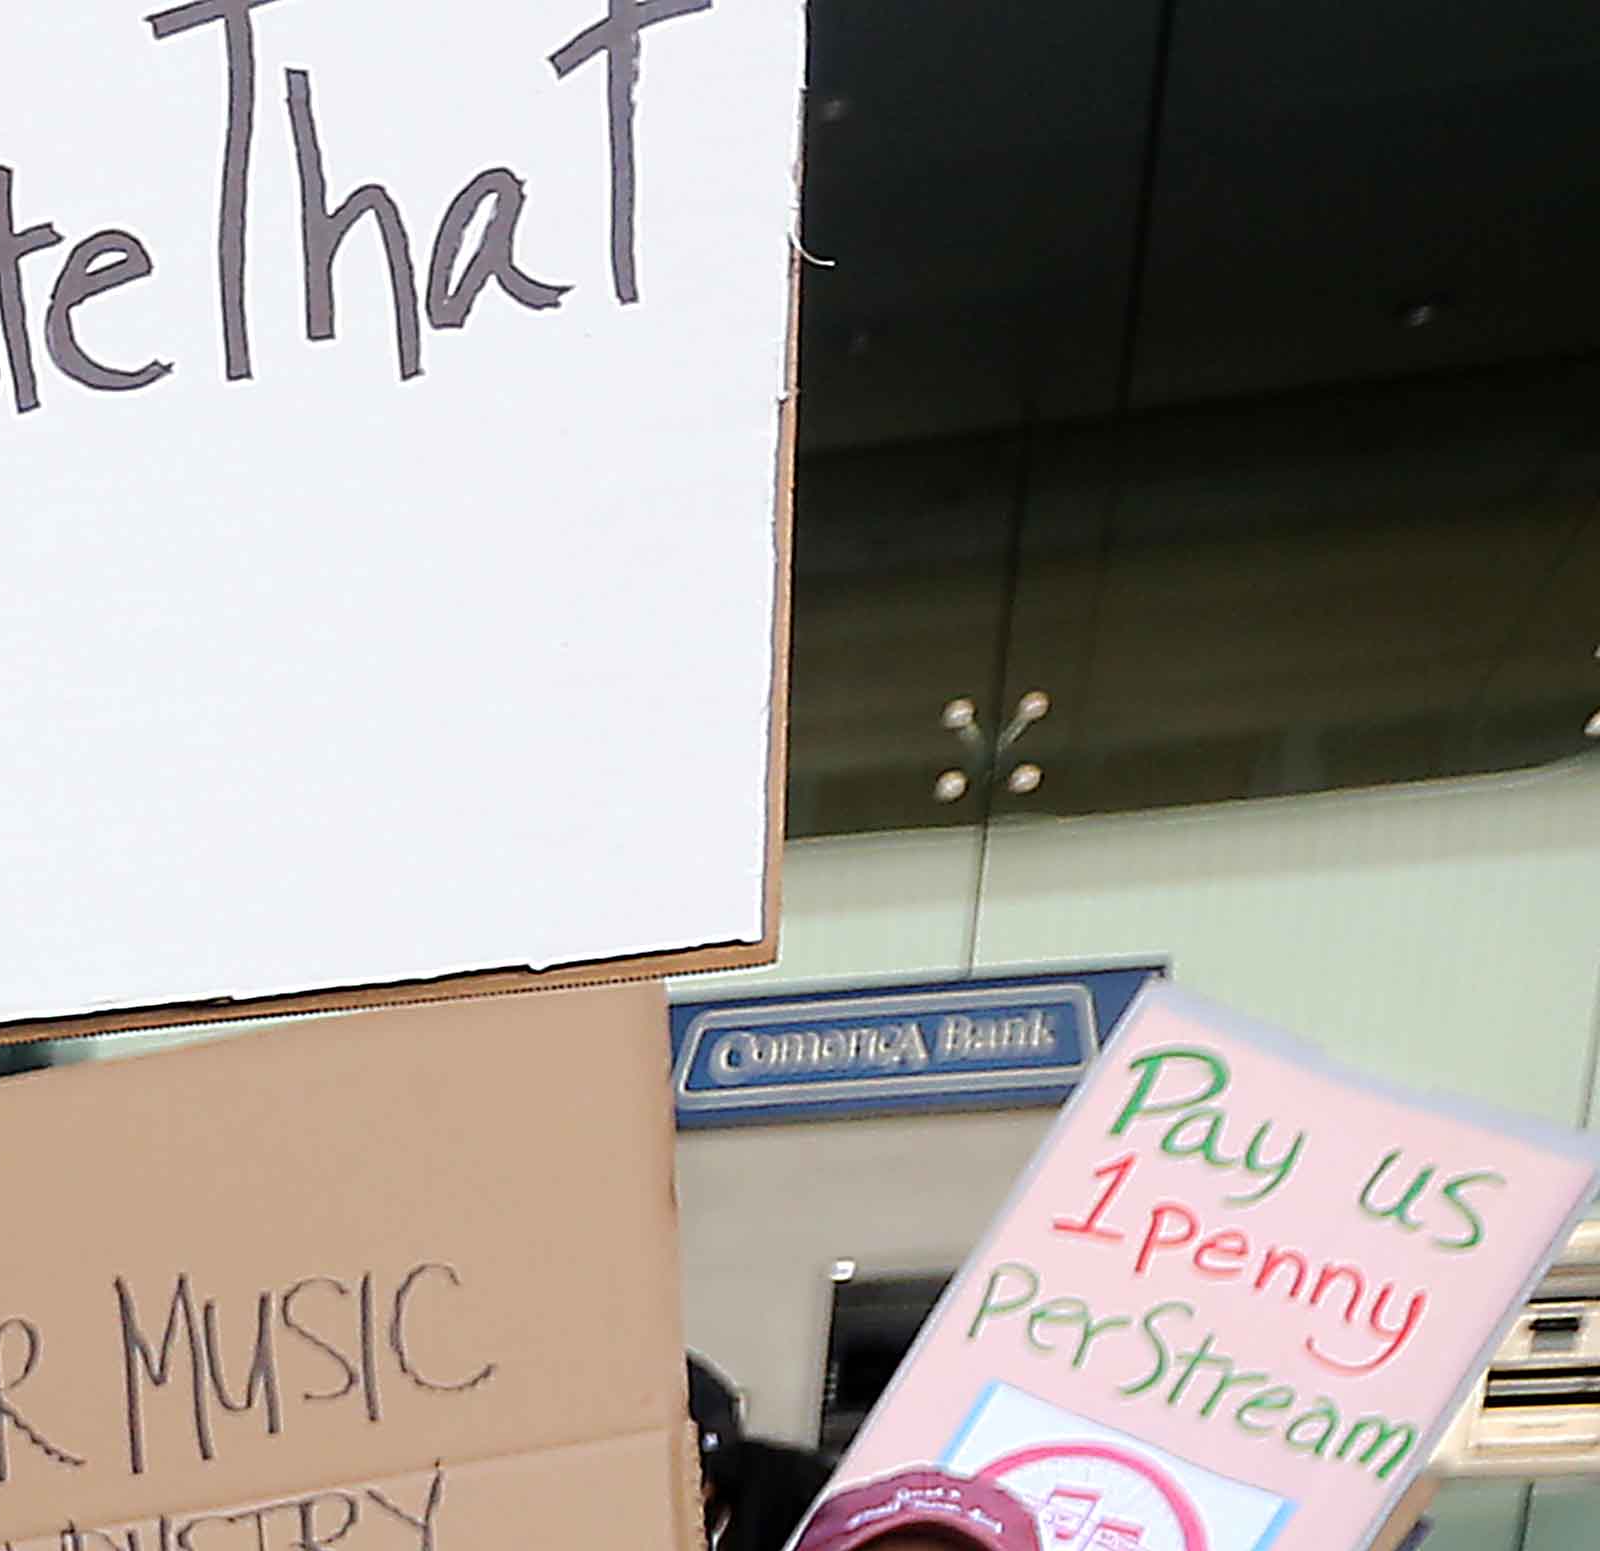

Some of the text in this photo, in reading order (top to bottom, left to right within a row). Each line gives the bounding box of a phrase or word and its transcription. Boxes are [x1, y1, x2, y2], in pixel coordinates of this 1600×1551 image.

[939, 1011, 1055, 1056] Bank
[1106, 1045, 1505, 1251] Pay us
[114, 1261, 497, 1475] MUSIC
